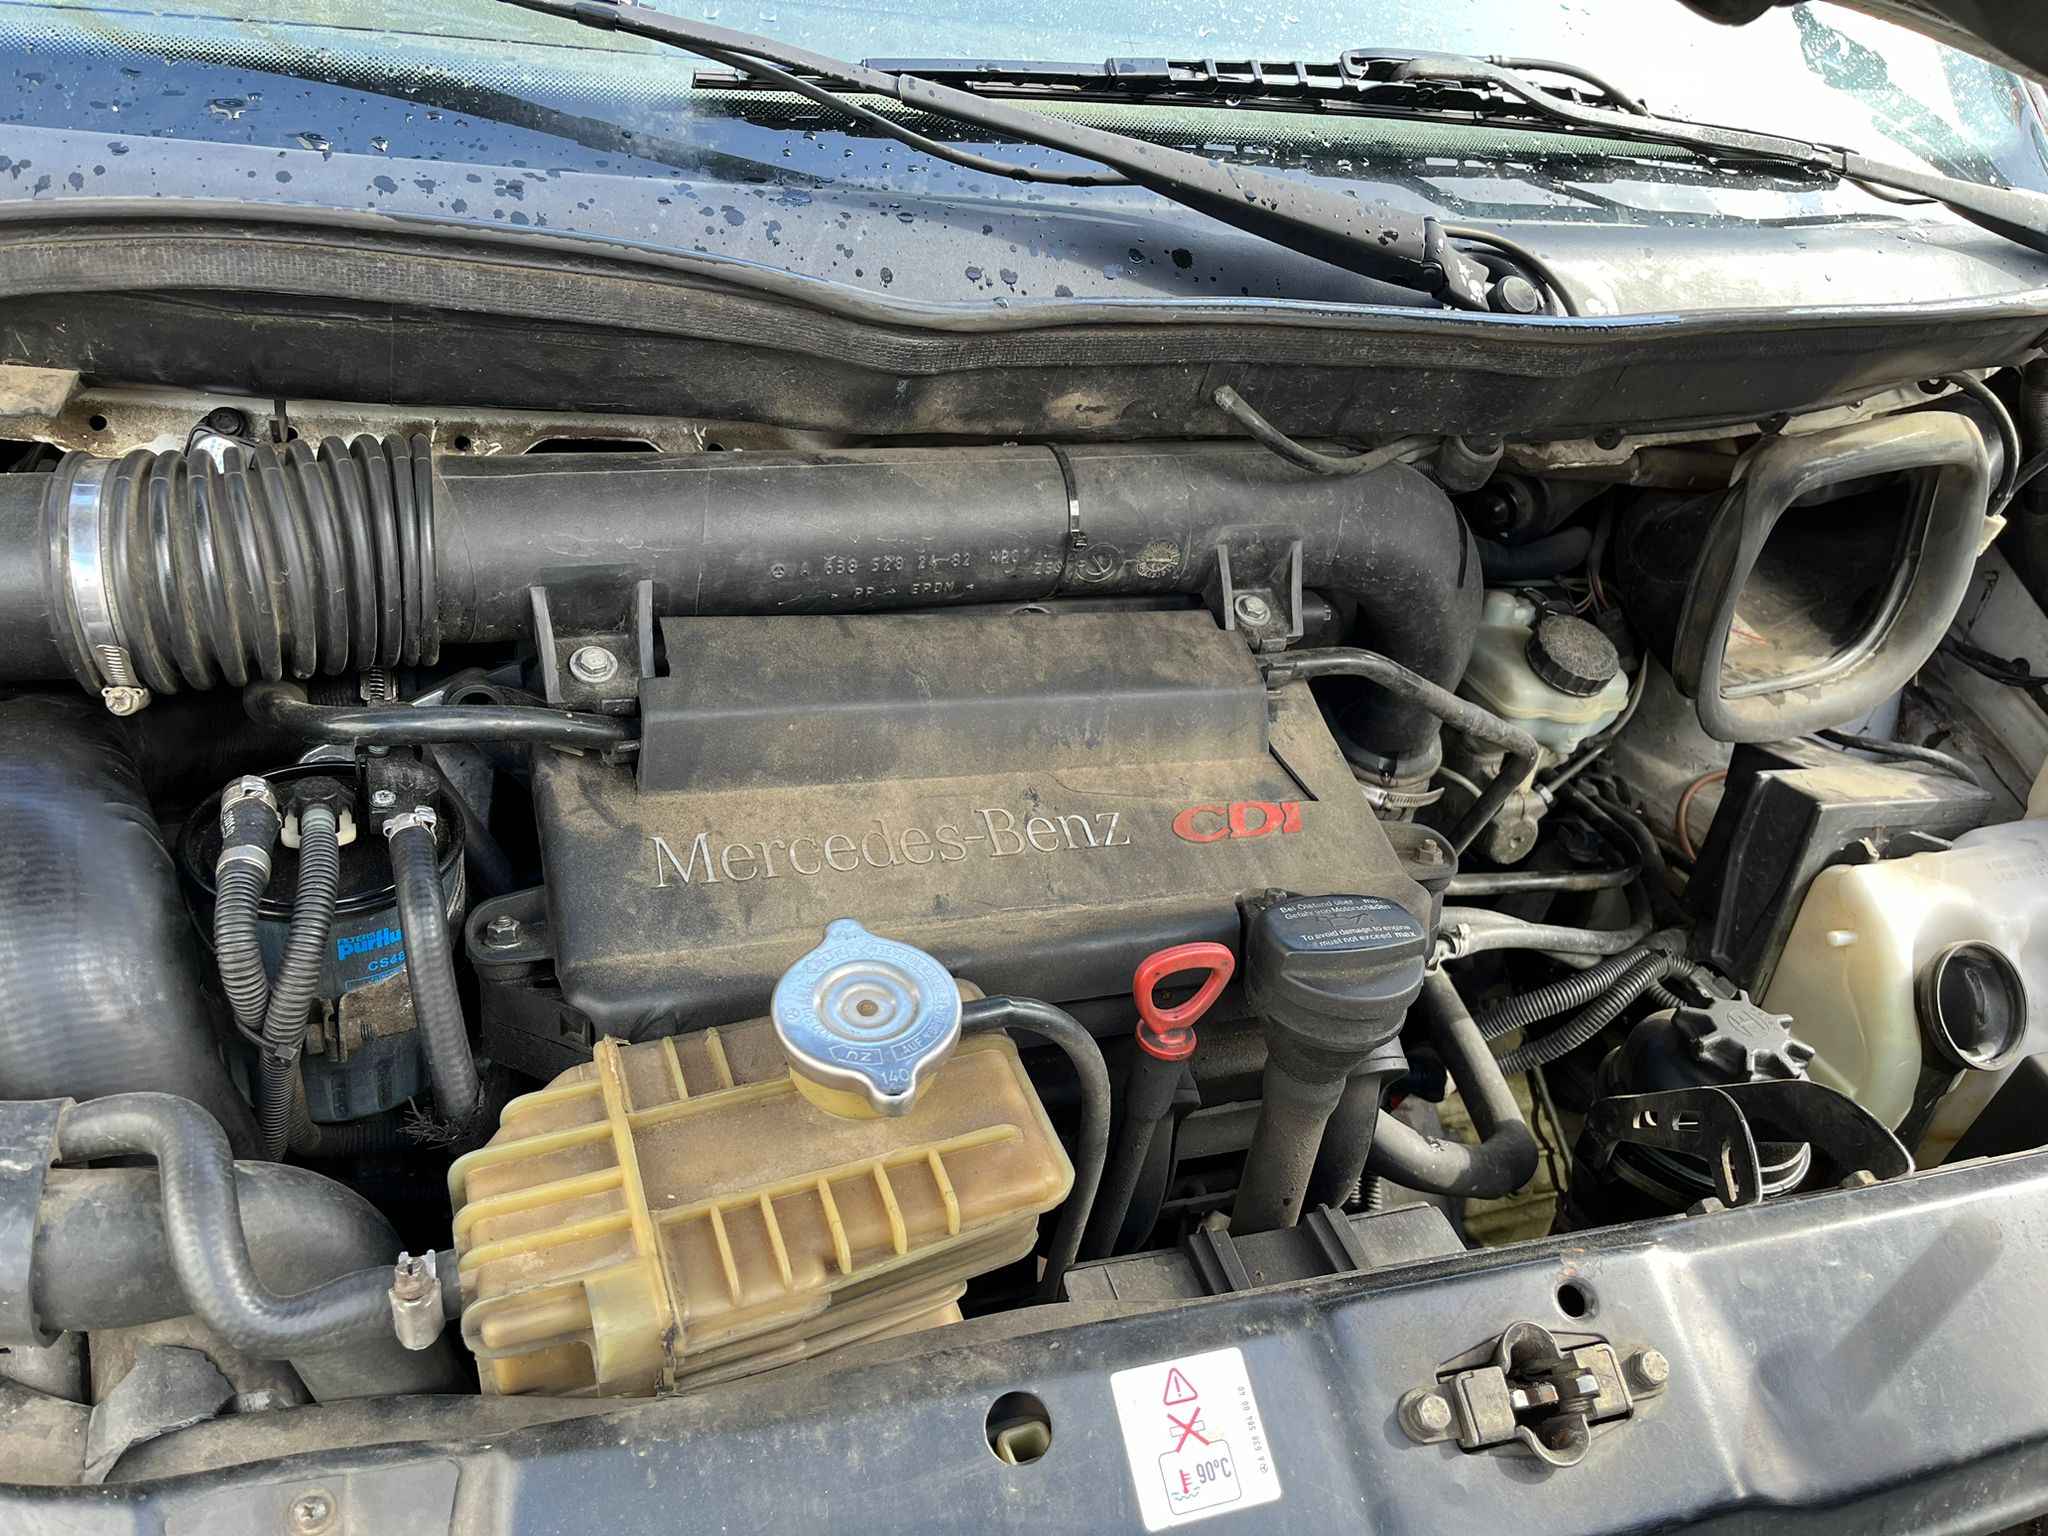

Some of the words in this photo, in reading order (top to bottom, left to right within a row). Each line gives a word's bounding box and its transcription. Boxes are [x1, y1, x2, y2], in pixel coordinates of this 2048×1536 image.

[912, 581, 955, 595] EPDM
[648, 807, 1131, 889] Mercedes-Benz
[1171, 801, 1302, 843] CDI
[1314, 930, 1339, 940] avoid
[1339, 927, 1372, 936] damage
[1319, 937, 1343, 947] must
[1343, 935, 1359, 943] not
[1359, 932, 1392, 941] exceed
[901, 1036, 922, 1054] AUF
[845, 1049, 873, 1062] ZU
[880, 1068, 909, 1084] 140
[1241, 1400, 1251, 1411] 00
[1246, 1415, 1257, 1431] 584
[1252, 1435, 1262, 1451] 638
[1196, 1457, 1232, 1484] 90°C
